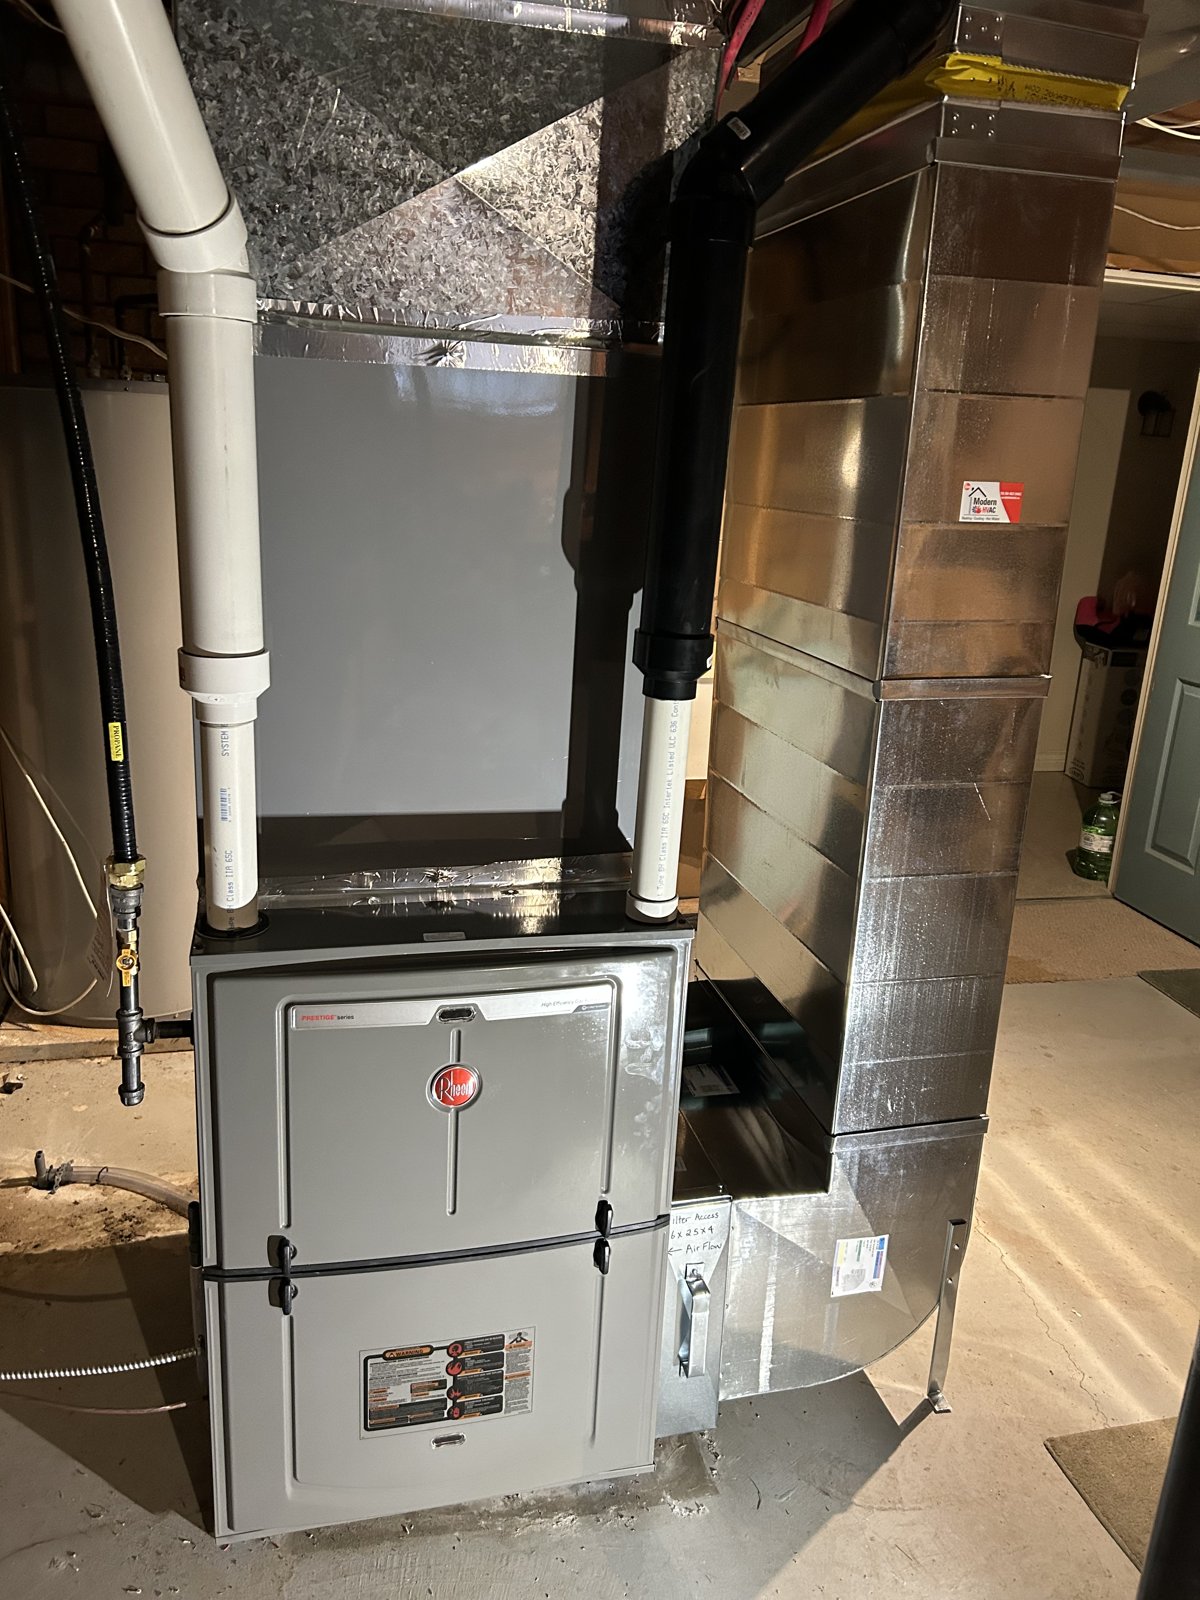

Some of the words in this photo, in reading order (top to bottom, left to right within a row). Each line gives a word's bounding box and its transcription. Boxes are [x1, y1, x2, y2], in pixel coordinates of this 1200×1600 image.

[973, 498, 997, 506] Modern
[113, 725, 122, 759] PROPANE
[221, 731, 230, 757] SYSTEM
[668, 736, 677, 749] ULC
[666, 752, 675, 776] Listed
[663, 780, 672, 809] Intertek
[659, 843, 668, 861] Class
[440, 1070, 475, 1102] Rheem
[672, 1215, 692, 1225] ilter
[695, 1212, 719, 1221] Access
[395, 1349, 424, 1358] WARNING
